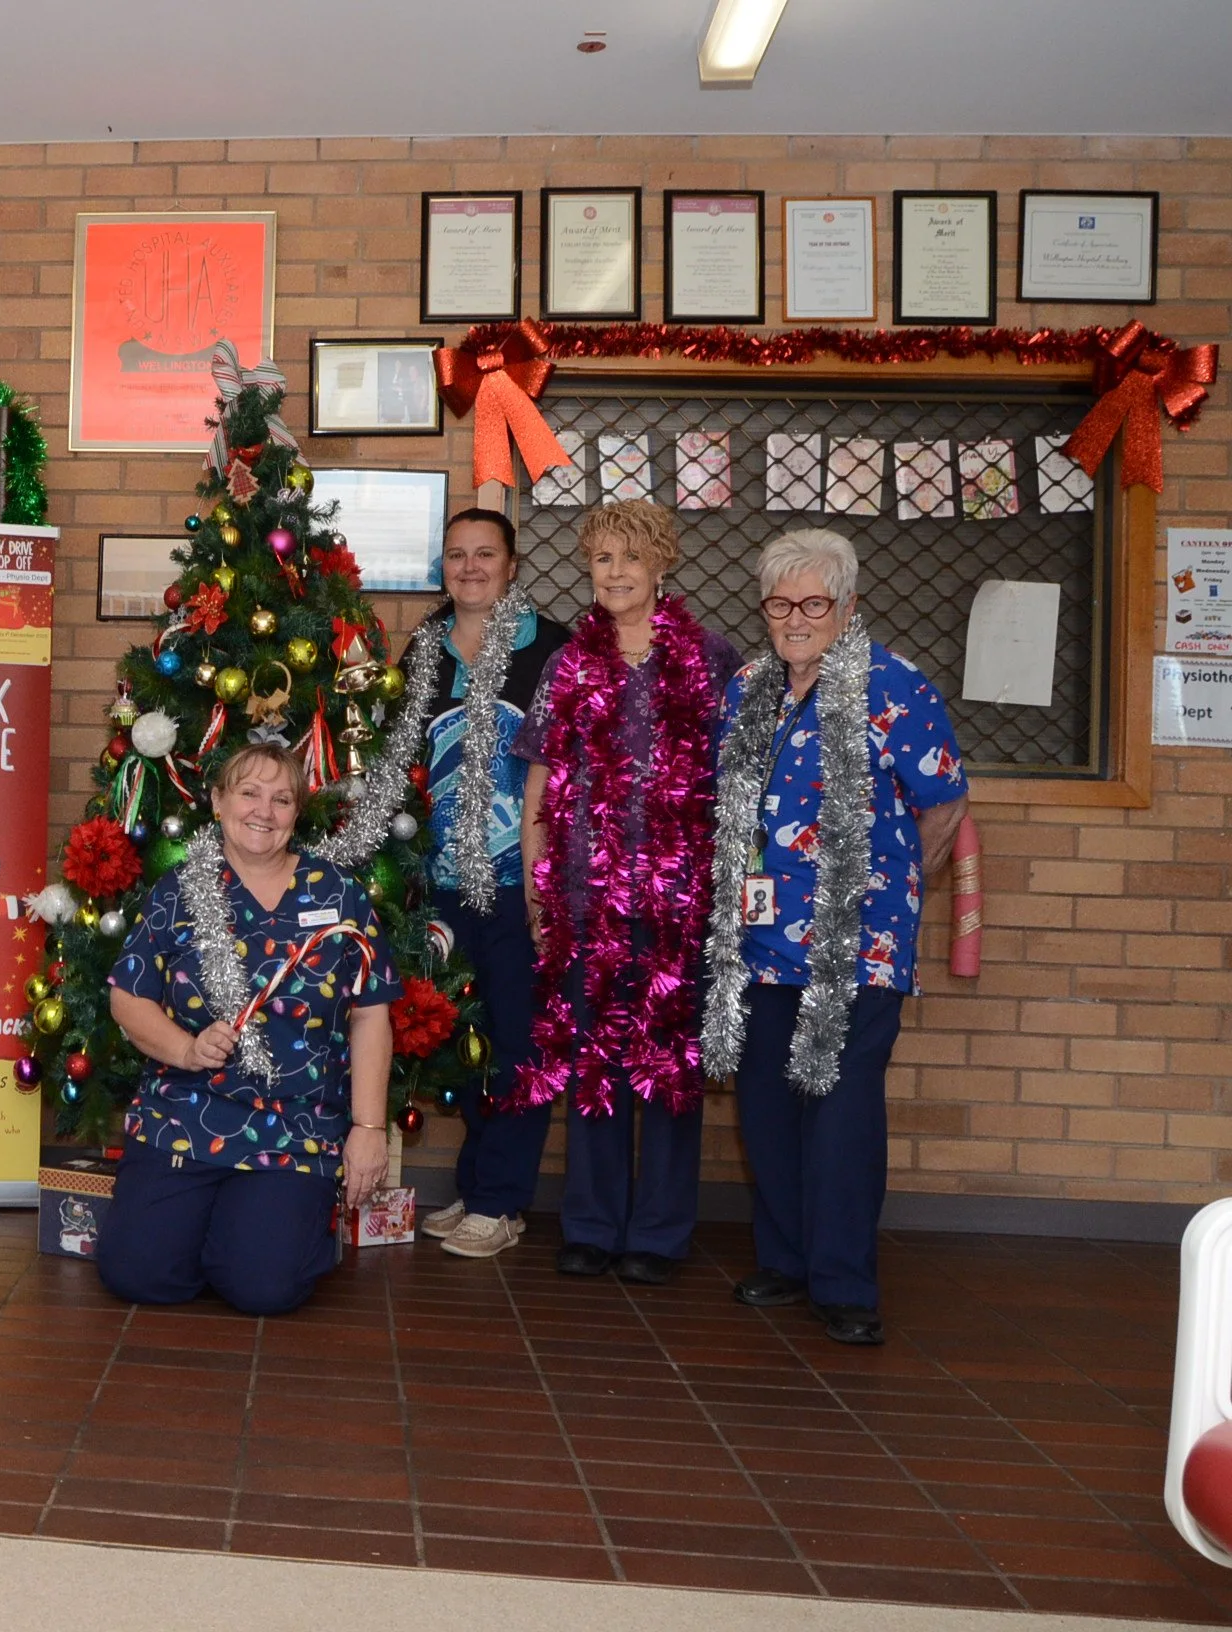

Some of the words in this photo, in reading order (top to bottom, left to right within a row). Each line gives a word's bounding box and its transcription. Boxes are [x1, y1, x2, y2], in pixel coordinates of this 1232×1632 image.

[128, 232, 190, 272] HOSPITAL
[145, 249, 214, 330] UHA
[9, 541, 34, 556] DRIVE
[16, 556, 32, 570] OFF
[6, 573, 30, 582] Physio
[31, 574, 48, 583] Dept
[1174, 641, 1202, 650] CASH
[1176, 705, 1213, 722] Dept
[4, 1125, 20, 1134] who
